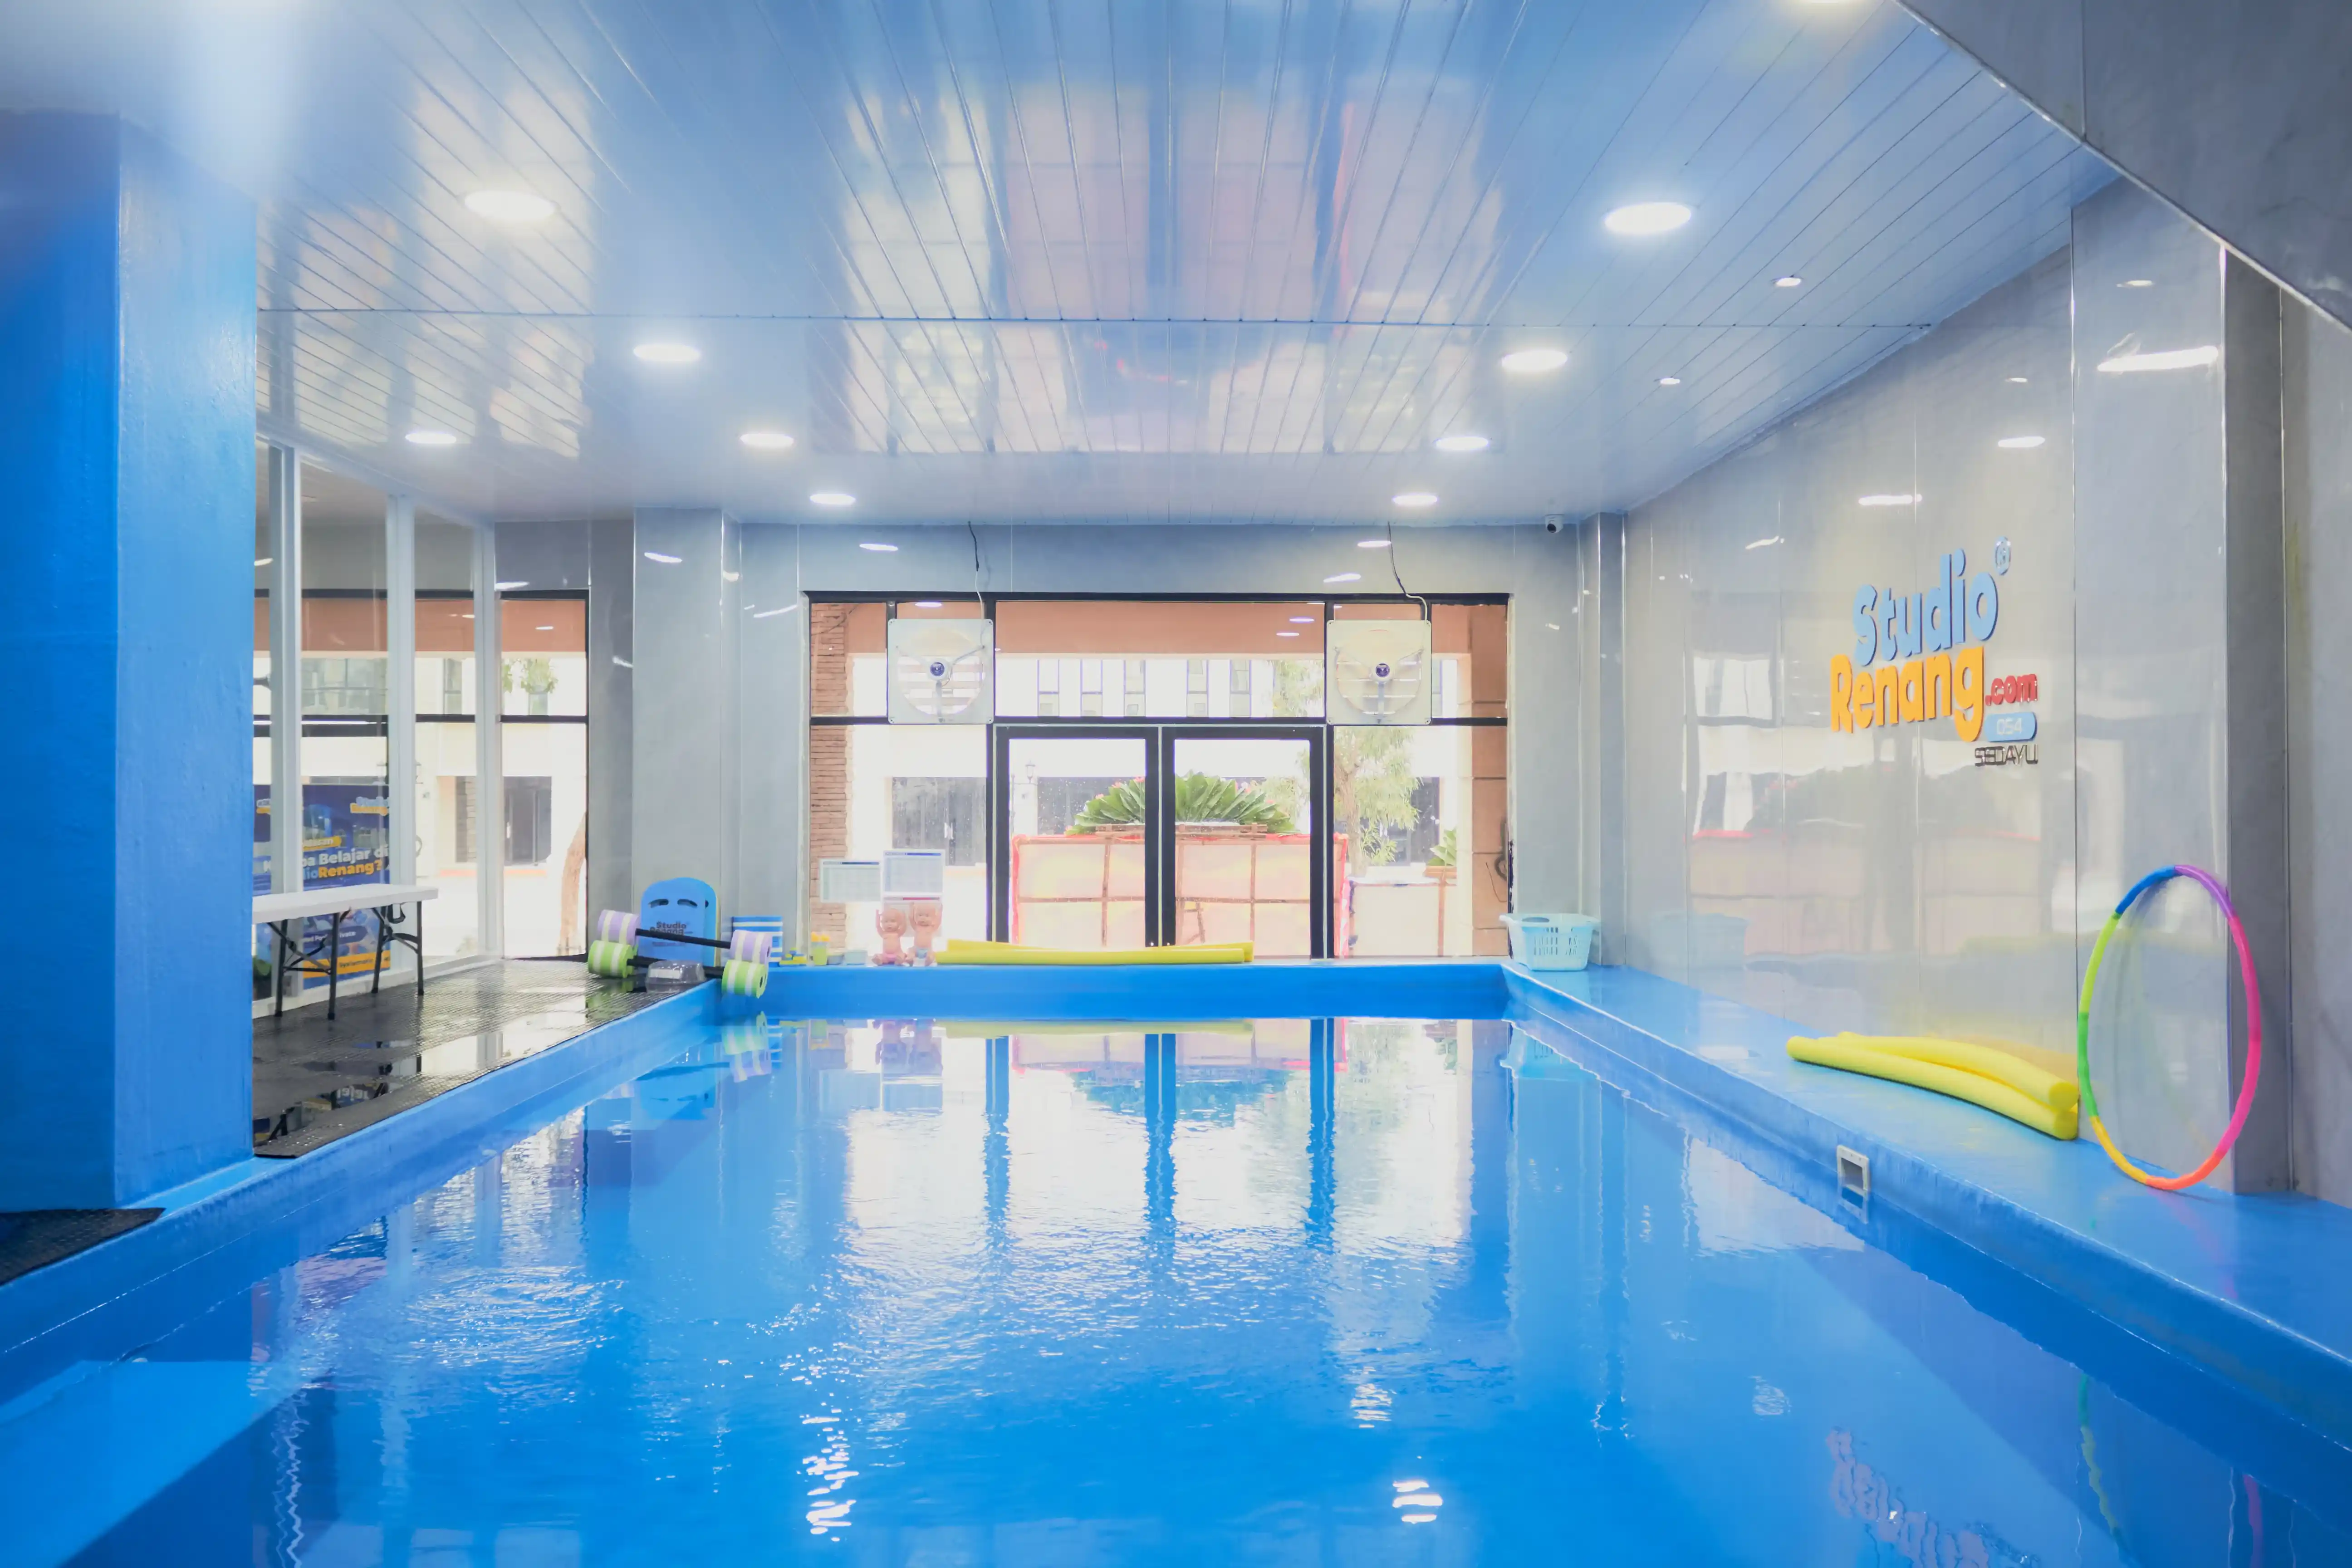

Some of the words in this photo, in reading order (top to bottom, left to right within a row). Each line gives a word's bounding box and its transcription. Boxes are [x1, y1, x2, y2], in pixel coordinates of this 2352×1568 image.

[1852, 548, 1998, 666] Studio
[1830, 646, 1984, 742] Renang
[1997, 717, 2023, 735] 054
[1975, 744, 2038, 767] SEDAYU
[319, 848, 371, 865] Belajar
